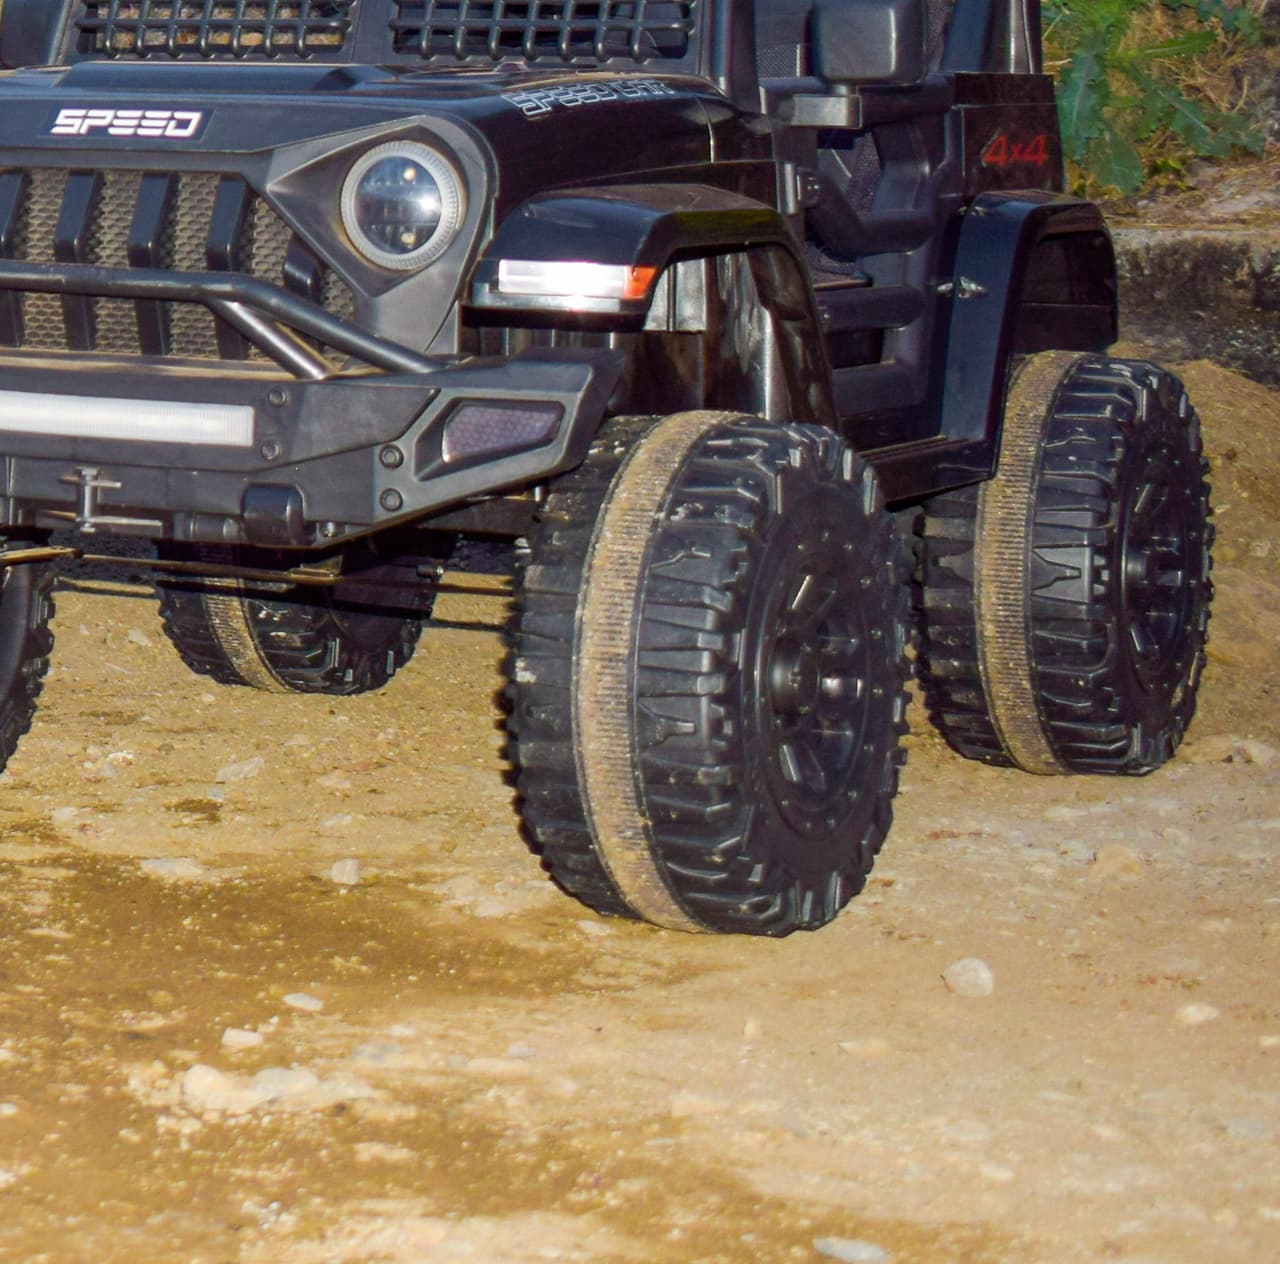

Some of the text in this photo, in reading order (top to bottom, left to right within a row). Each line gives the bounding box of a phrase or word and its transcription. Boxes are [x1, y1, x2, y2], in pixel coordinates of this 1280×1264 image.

[501, 82, 617, 116] SPEED
[51, 108, 203, 137] SPEED
[983, 133, 1049, 167] 4x4
